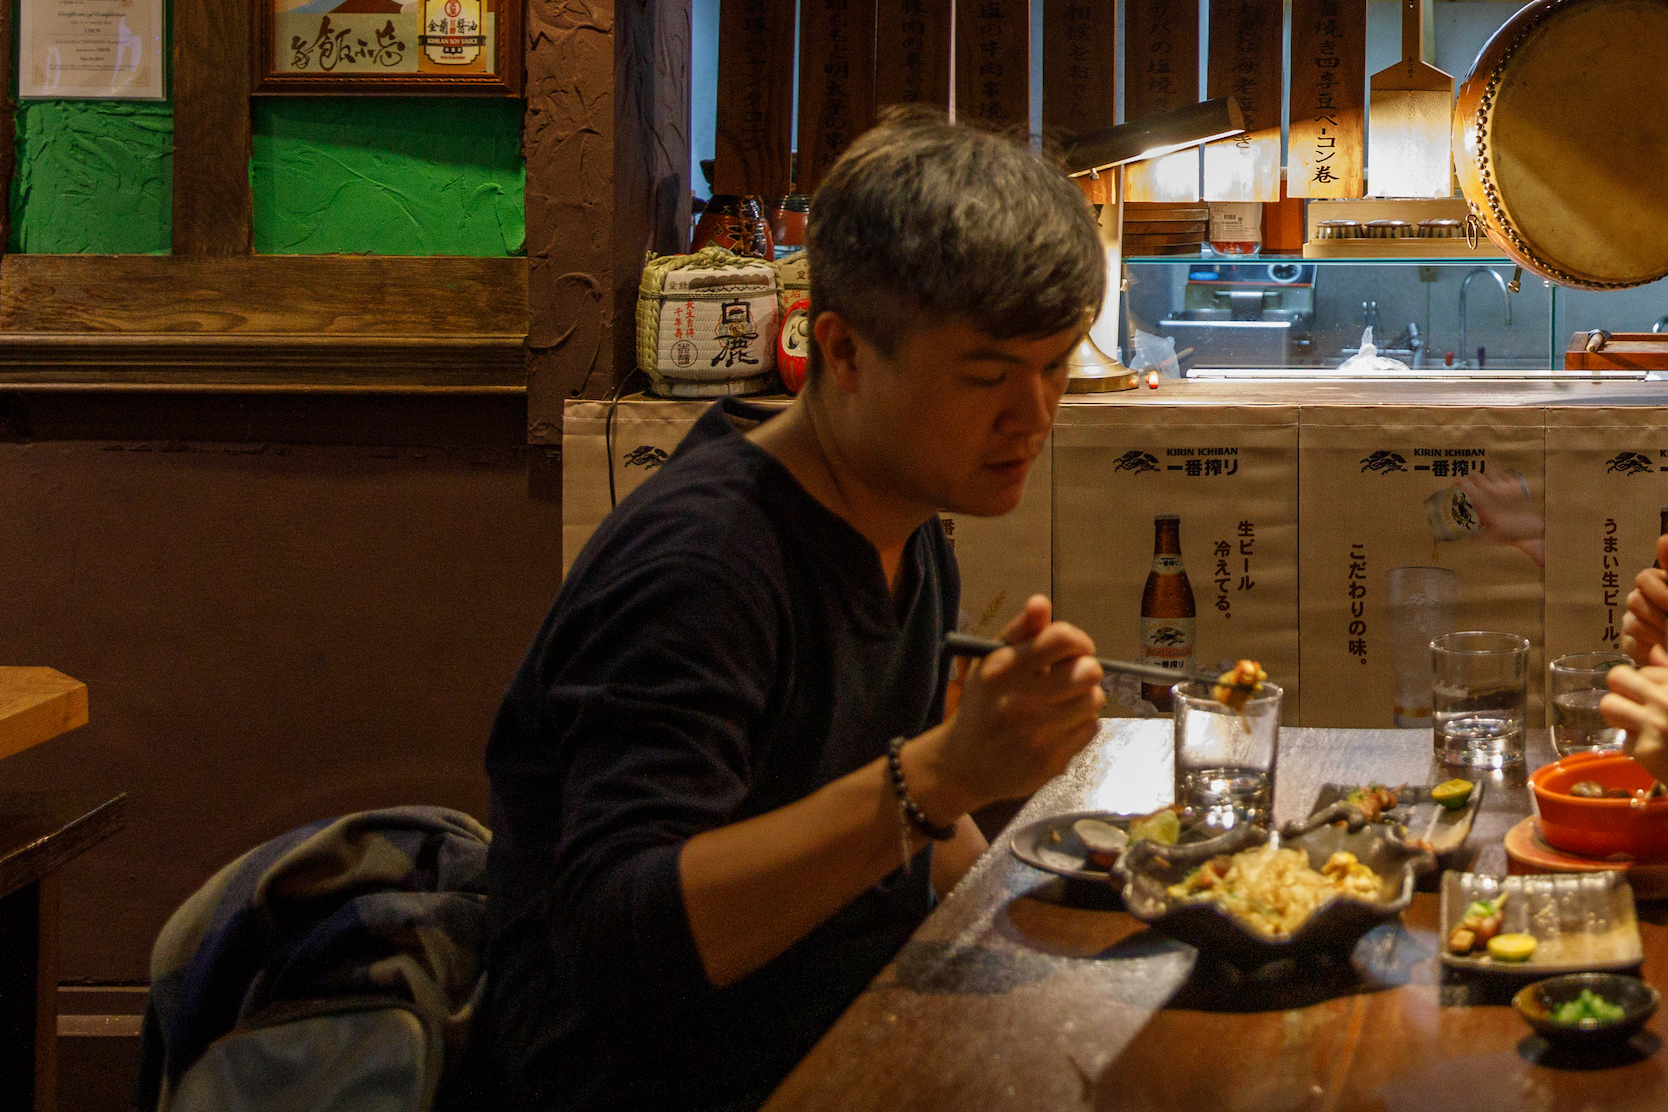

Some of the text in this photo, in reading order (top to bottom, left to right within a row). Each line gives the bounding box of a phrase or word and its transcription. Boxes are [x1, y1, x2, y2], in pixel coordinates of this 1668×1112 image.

[1167, 448, 1238, 456] KIRIN ICHIBAN
[1167, 459, 1239, 476] 一番搾り
[1414, 449, 1485, 457] KIRIN ICHIBAN
[1414, 460, 1485, 477] 一番搾り
[1238, 520, 1255, 591] 生ビール
[1215, 541, 1232, 618] 冷えてる。
[1602, 518, 1620, 650] うまい生ビール。
[1349, 544, 1367, 665] こだわりの味。
